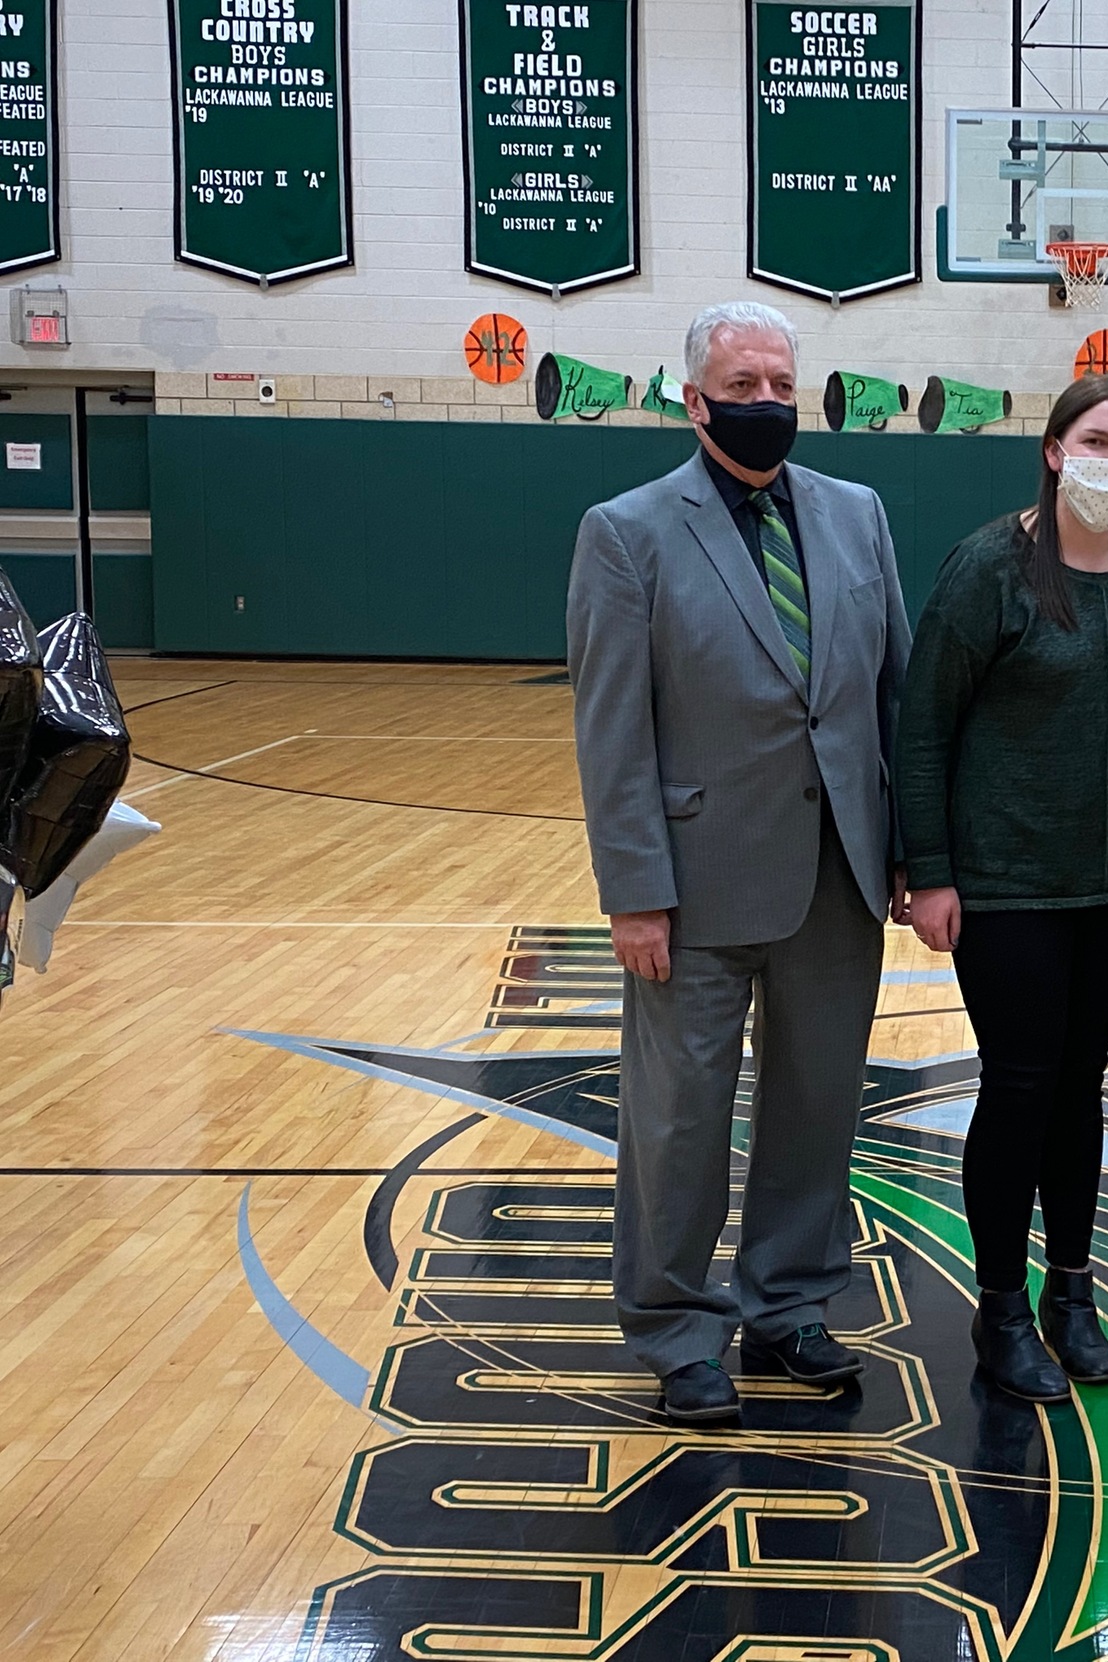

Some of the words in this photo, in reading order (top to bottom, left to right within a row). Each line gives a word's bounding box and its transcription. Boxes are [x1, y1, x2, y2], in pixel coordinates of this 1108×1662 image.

[220, 0, 295, 19] CROSS
[505, 4, 590, 28] TRACK
[201, 18, 315, 44] COUNTRY
[790, 11, 877, 36] SOCCER
[540, 29, 556, 52] &
[802, 36, 865, 58] GIRLS
[231, 44, 286, 66] BOYS
[513, 53, 582, 77] FIELD
[194, 65, 325, 87] CHAMPIONS
[769, 57, 899, 78] CHAMPIONS
[483, 77, 616, 97] CHAMPIONS
[760, 80, 850, 99] LACKAWANNA
[856, 83, 908, 101] LEAGUE
[185, 87, 273, 107] LACKAWANNA
[281, 90, 334, 109] LEAGUE
[525, 98, 574, 115] BOYS
[764, 97, 786, 115] '13
[184, 104, 208, 123] '19
[488, 113, 563, 128] LACKAWANNA
[567, 115, 612, 130] LEAGUE
[500, 143, 554, 157] DISTRICT
[563, 144, 575, 158] II
[200, 169, 264, 187] DISTRICT
[275, 170, 288, 187] II
[524, 172, 579, 189] GIRLS
[772, 172, 836, 192] DISTRICT
[844, 175, 858, 192] II
[26, 184, 47, 203] '18
[191, 185, 215, 204] '19
[218, 186, 244, 205] '20
[490, 187, 564, 202] LACKAWANNA
[570, 189, 615, 204] LEAGUE
[477, 201, 497, 216] '10
[502, 217, 556, 231] DISTRICT
[565, 218, 577, 232] II
[561, 367, 614, 411] Kelsey
[847, 379, 885, 417] Paige
[950, 390, 984, 416] Tia
